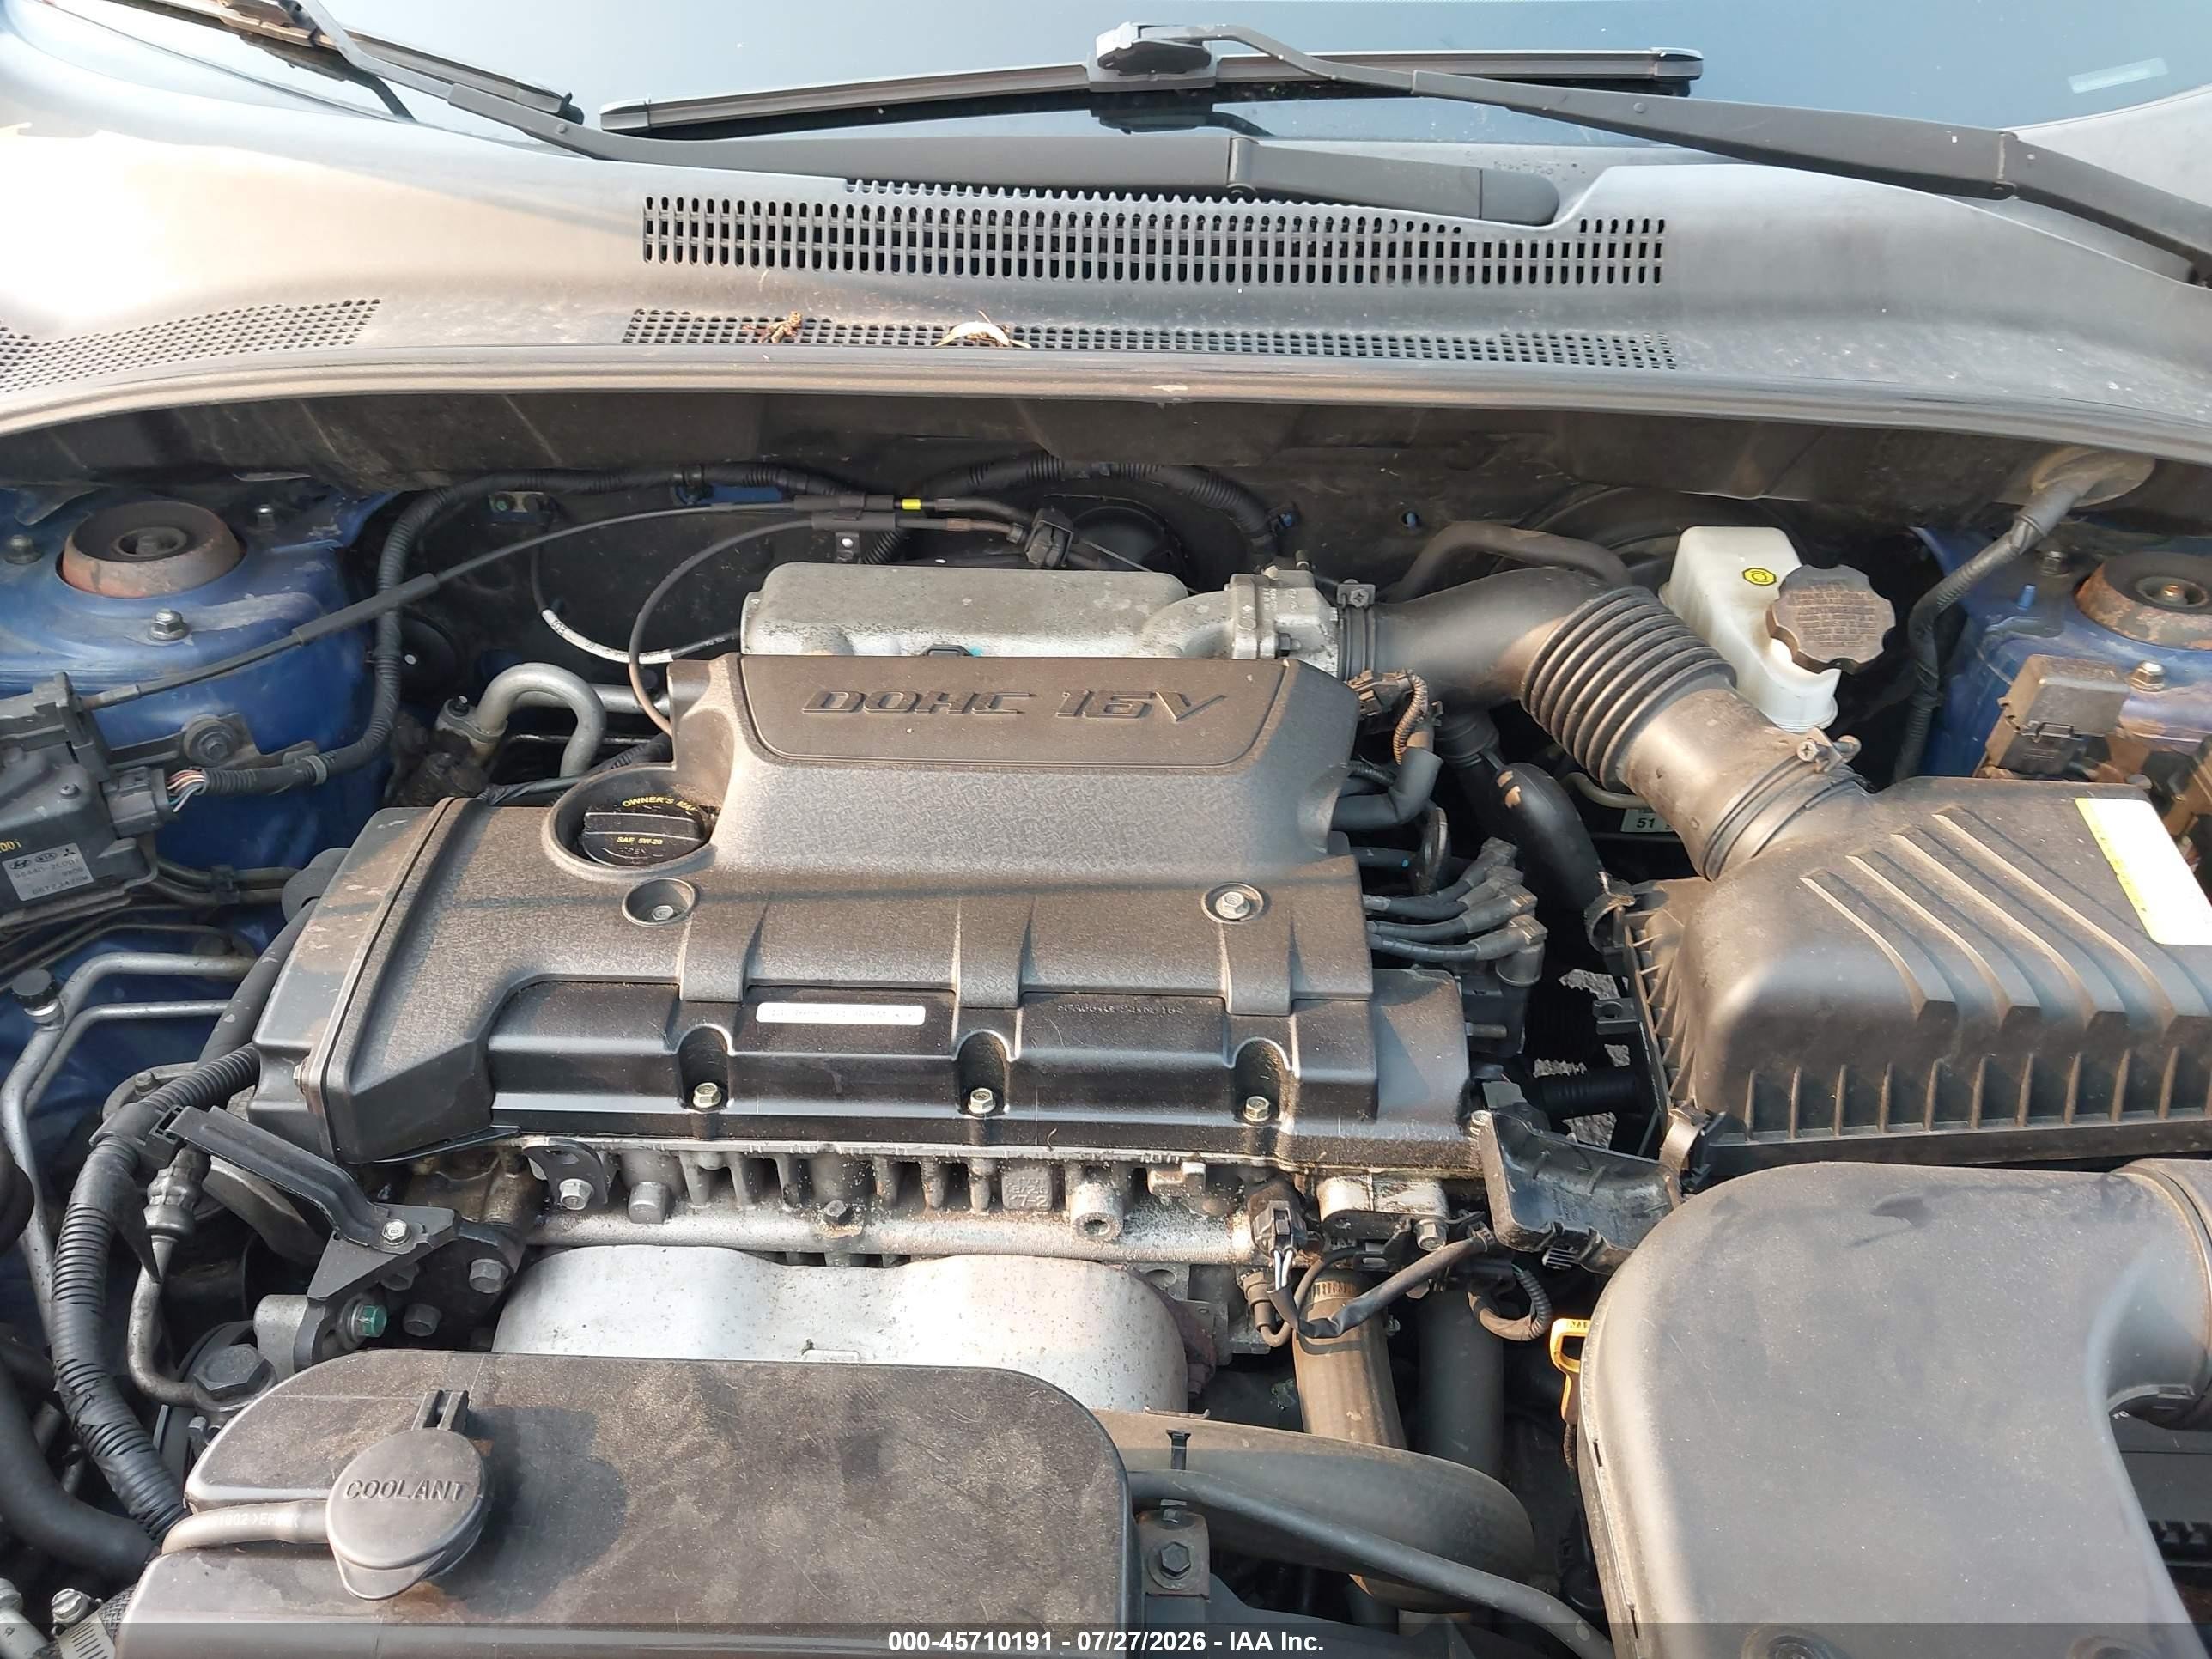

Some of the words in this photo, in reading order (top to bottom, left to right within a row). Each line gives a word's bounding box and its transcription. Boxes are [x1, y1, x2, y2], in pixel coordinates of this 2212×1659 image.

[802, 690, 1036, 714] DOHC
[1055, 690, 1227, 723] 16V
[622, 796, 674, 807] OWNER'S
[1636, 817, 1656, 829] 51
[345, 1479, 470, 1502] COOLANT
